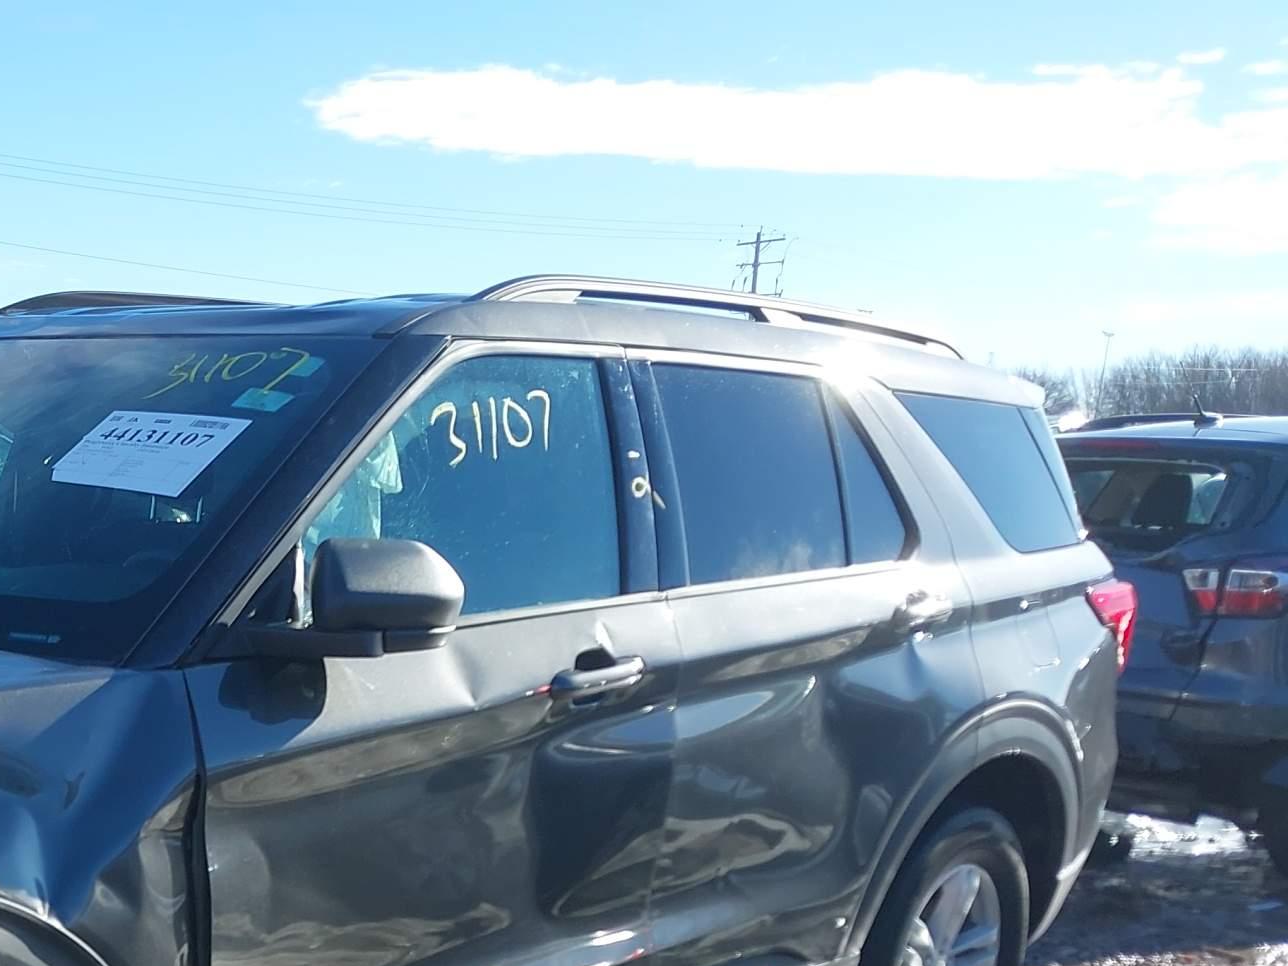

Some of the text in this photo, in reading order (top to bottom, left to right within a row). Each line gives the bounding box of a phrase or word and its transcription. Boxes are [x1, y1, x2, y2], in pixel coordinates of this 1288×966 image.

[143, 346, 311, 400] 31107
[99, 426, 215, 449] 44131107
[430, 388, 551, 468] 31107
